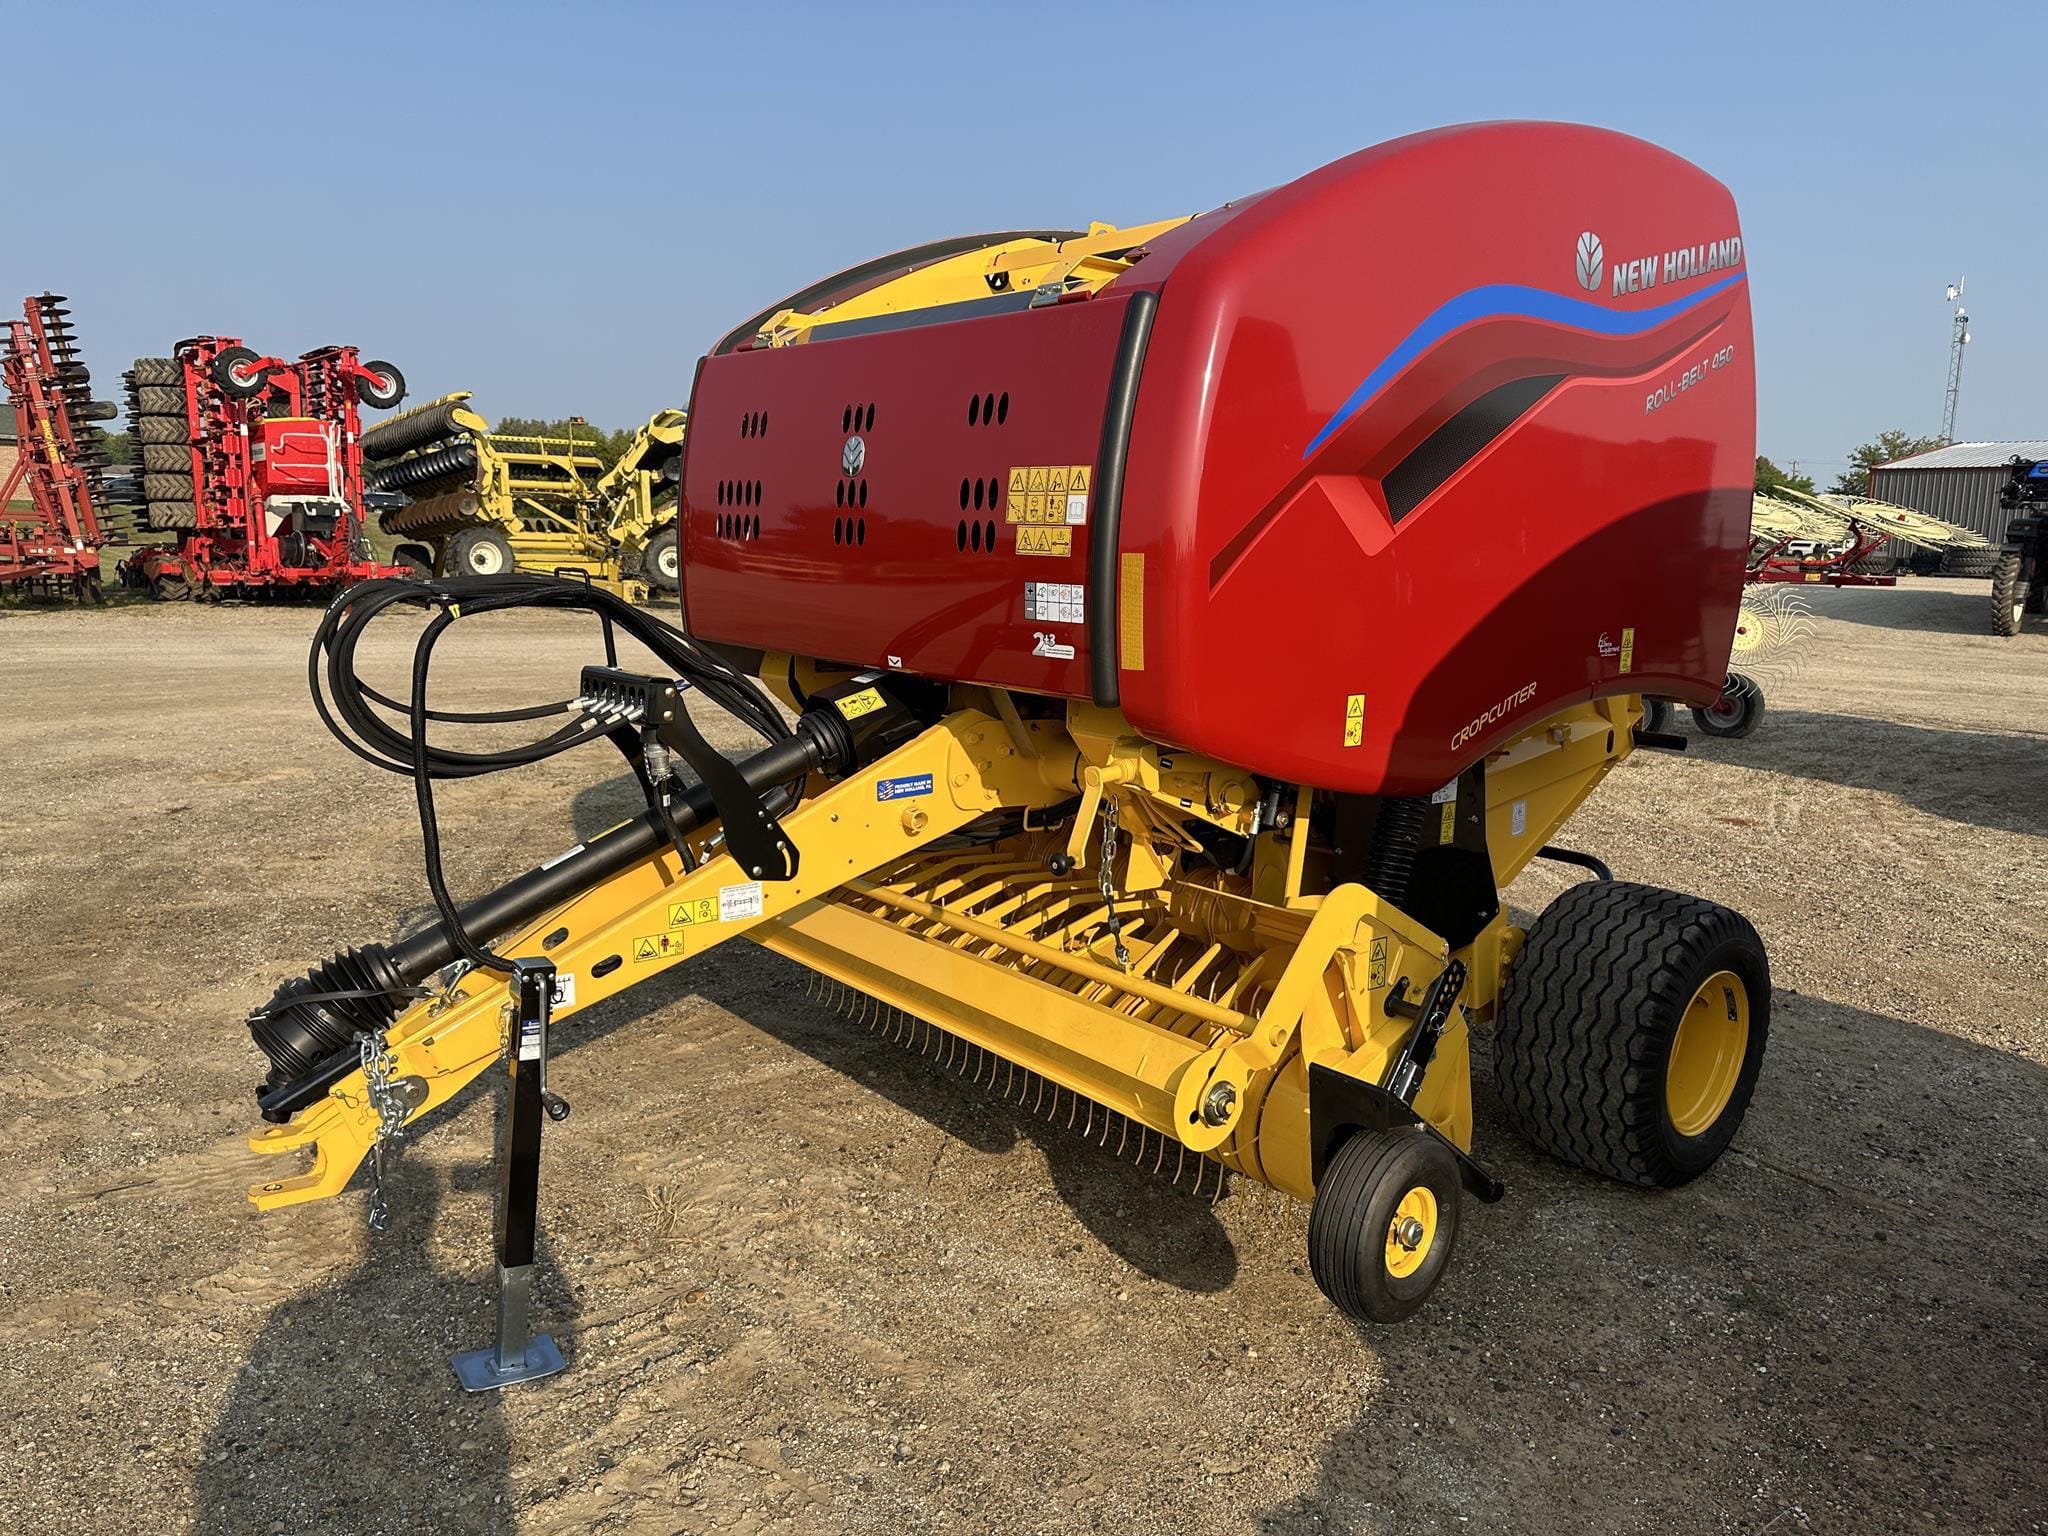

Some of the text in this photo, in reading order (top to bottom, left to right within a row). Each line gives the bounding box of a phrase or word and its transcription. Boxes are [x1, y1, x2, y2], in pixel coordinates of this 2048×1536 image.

[1611, 236, 1742, 298] NEW HOLLAND
[1645, 344, 1734, 416] ROLL-BELT 450
[1450, 681, 1537, 752] CROPCUTTER
